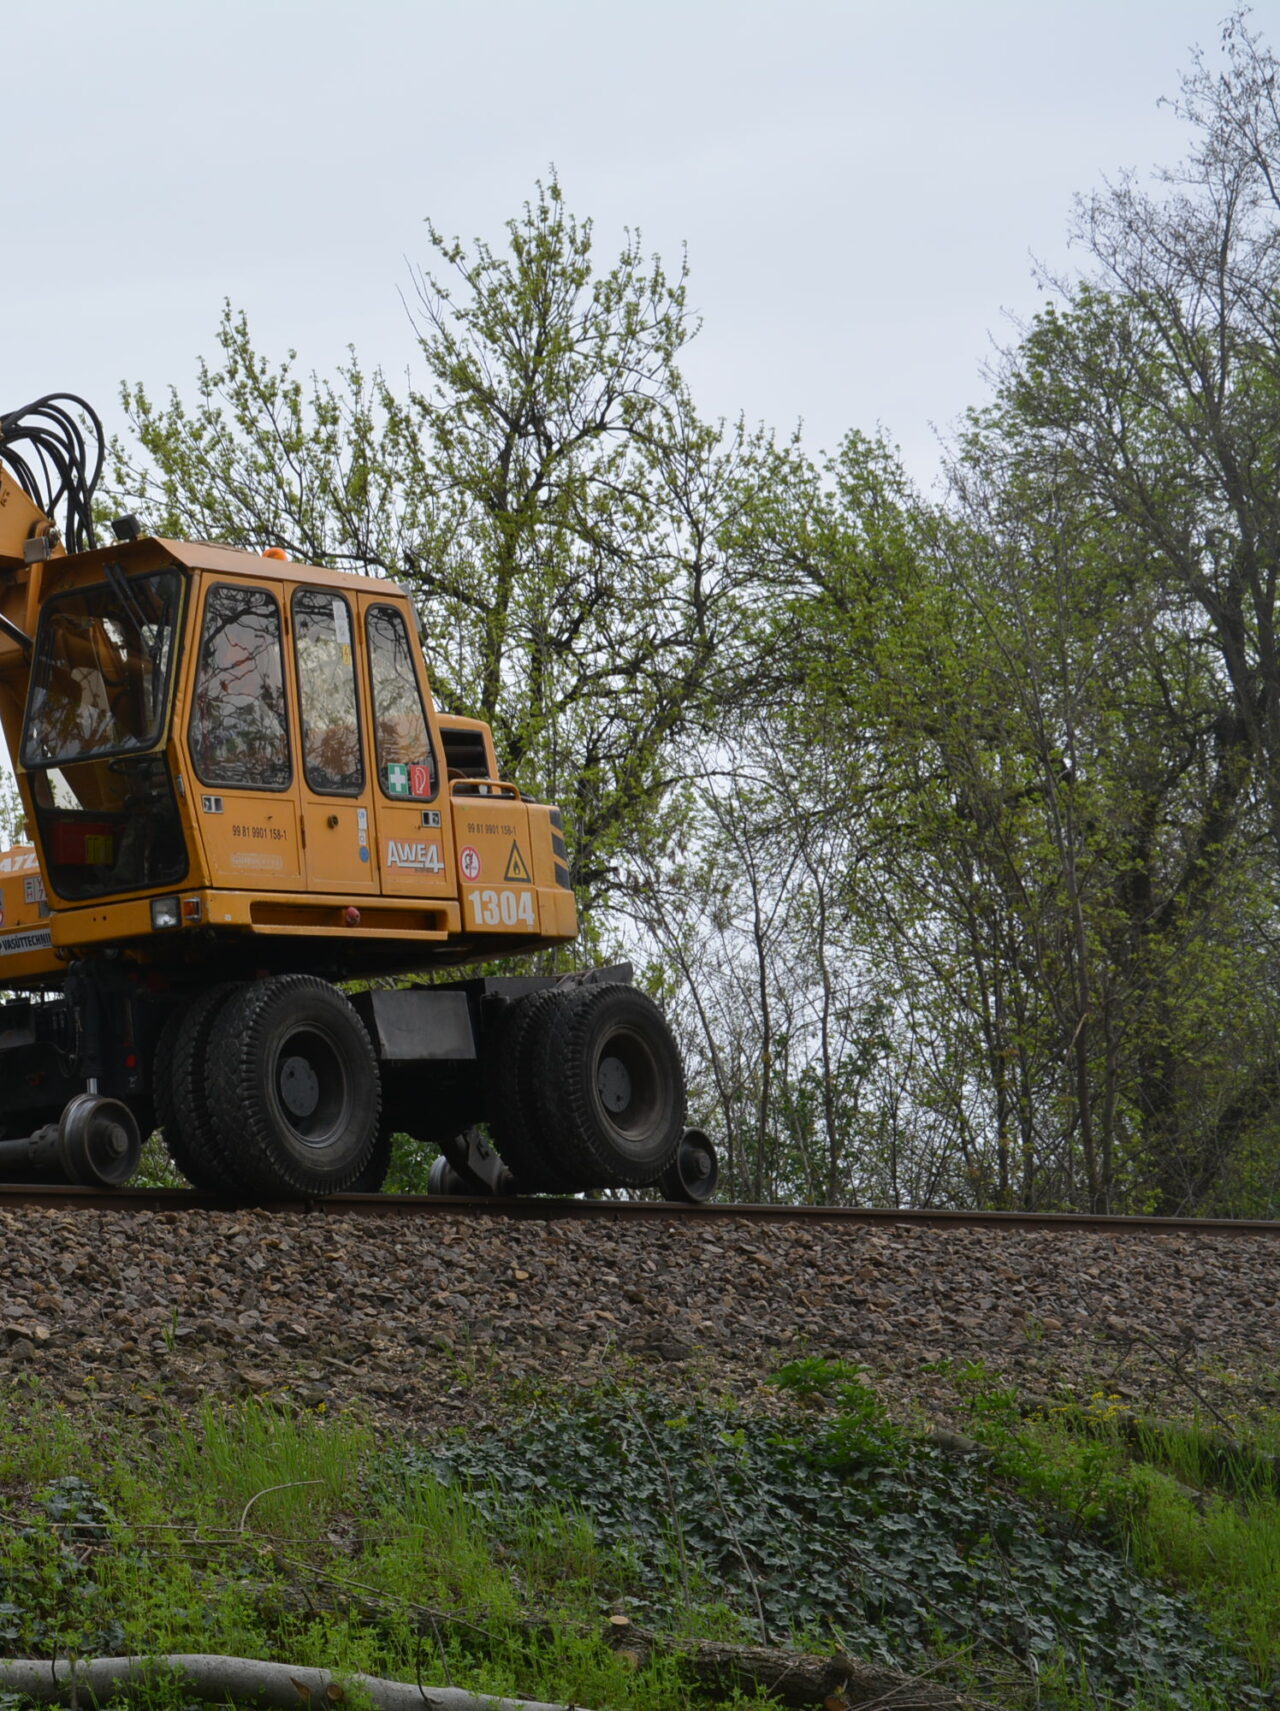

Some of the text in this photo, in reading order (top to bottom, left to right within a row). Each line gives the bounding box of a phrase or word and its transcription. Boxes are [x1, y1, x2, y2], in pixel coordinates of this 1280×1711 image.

[232, 825, 286, 840] 99 81 9901 158-1
[468, 890, 535, 931] 1304
